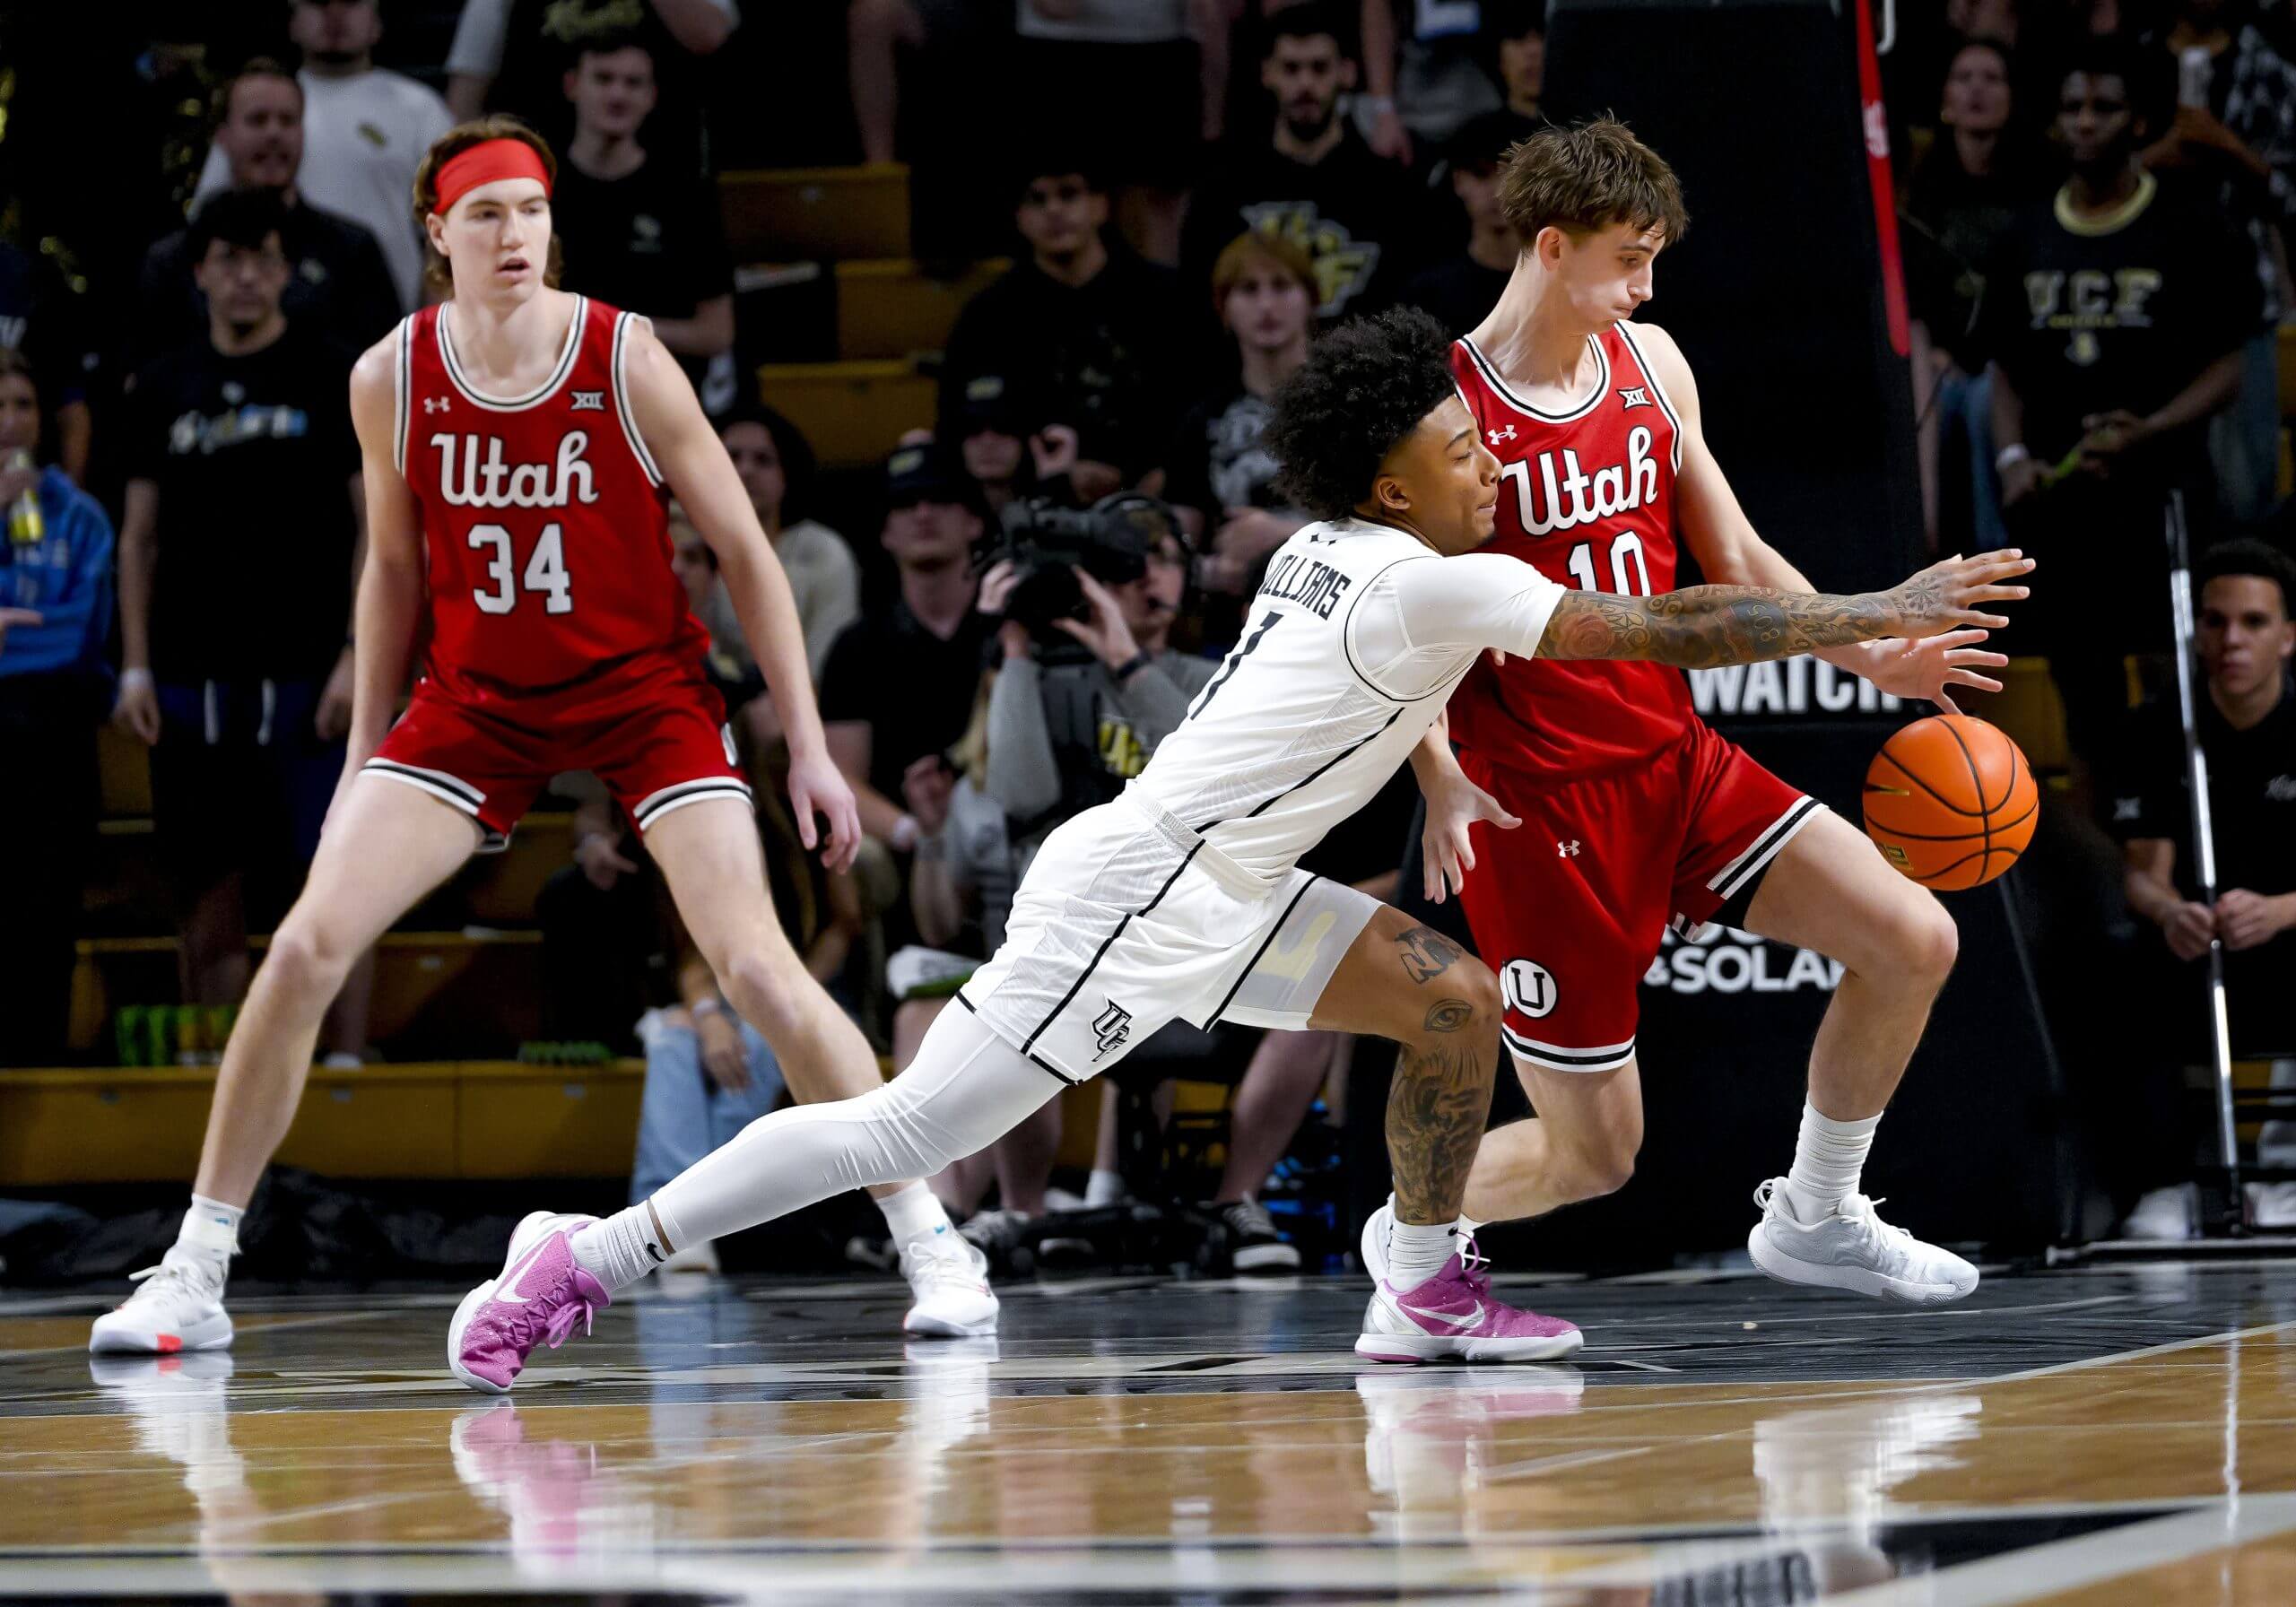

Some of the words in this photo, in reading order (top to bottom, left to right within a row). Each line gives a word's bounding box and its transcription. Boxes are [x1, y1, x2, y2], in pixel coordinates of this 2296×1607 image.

[430, 430, 599, 508] Utah
[1501, 424, 1658, 535] Utah
[467, 523, 573, 614] 34
[1569, 531, 1651, 597] 10
[1190, 611, 1284, 721] 1
